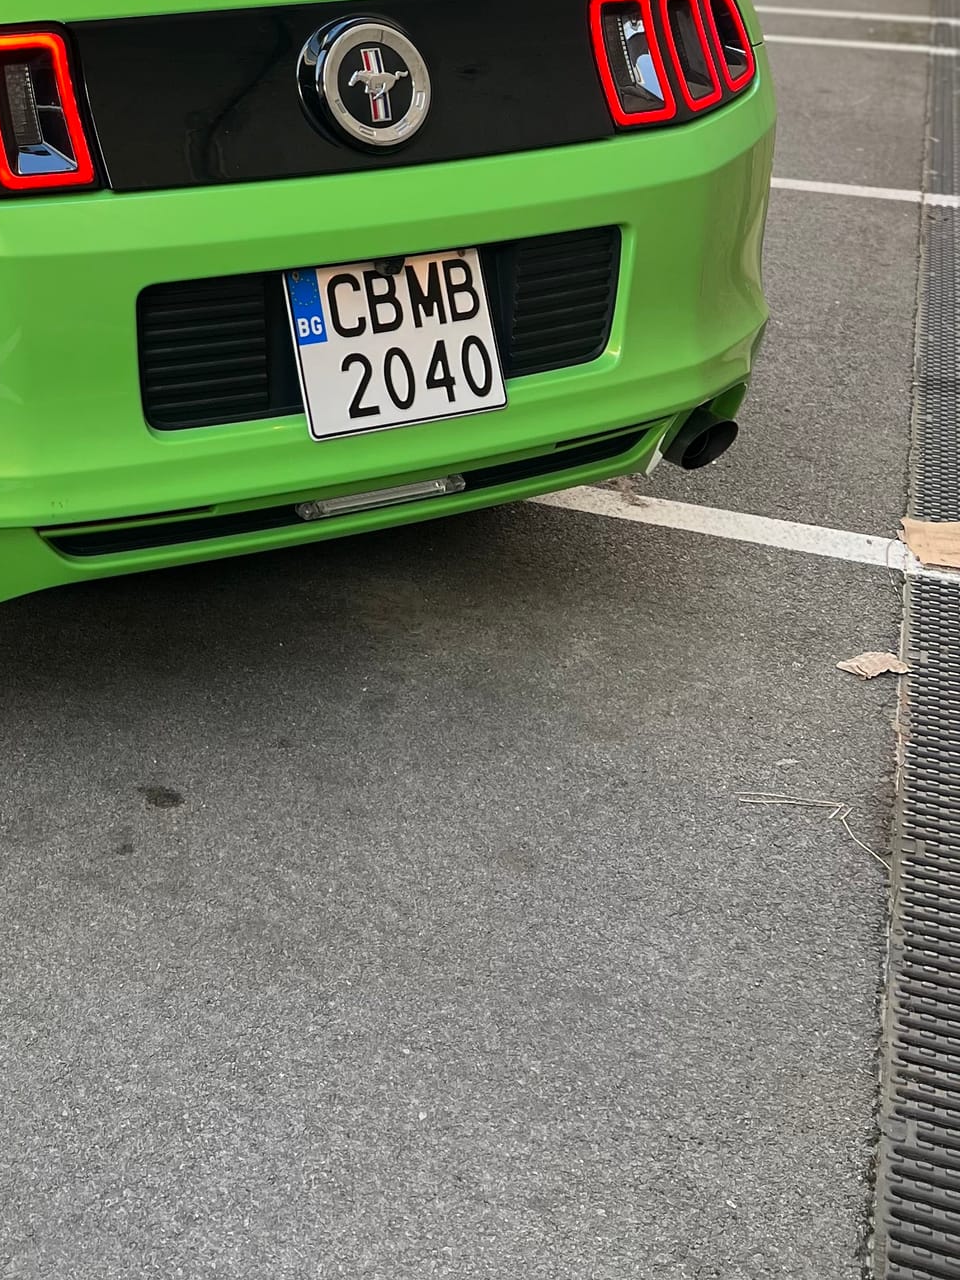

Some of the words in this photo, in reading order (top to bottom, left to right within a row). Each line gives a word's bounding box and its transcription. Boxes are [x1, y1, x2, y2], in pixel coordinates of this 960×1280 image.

[297, 316, 324, 338] BG
[327, 259, 480, 338] CBMB
[341, 335, 493, 419] 2040
